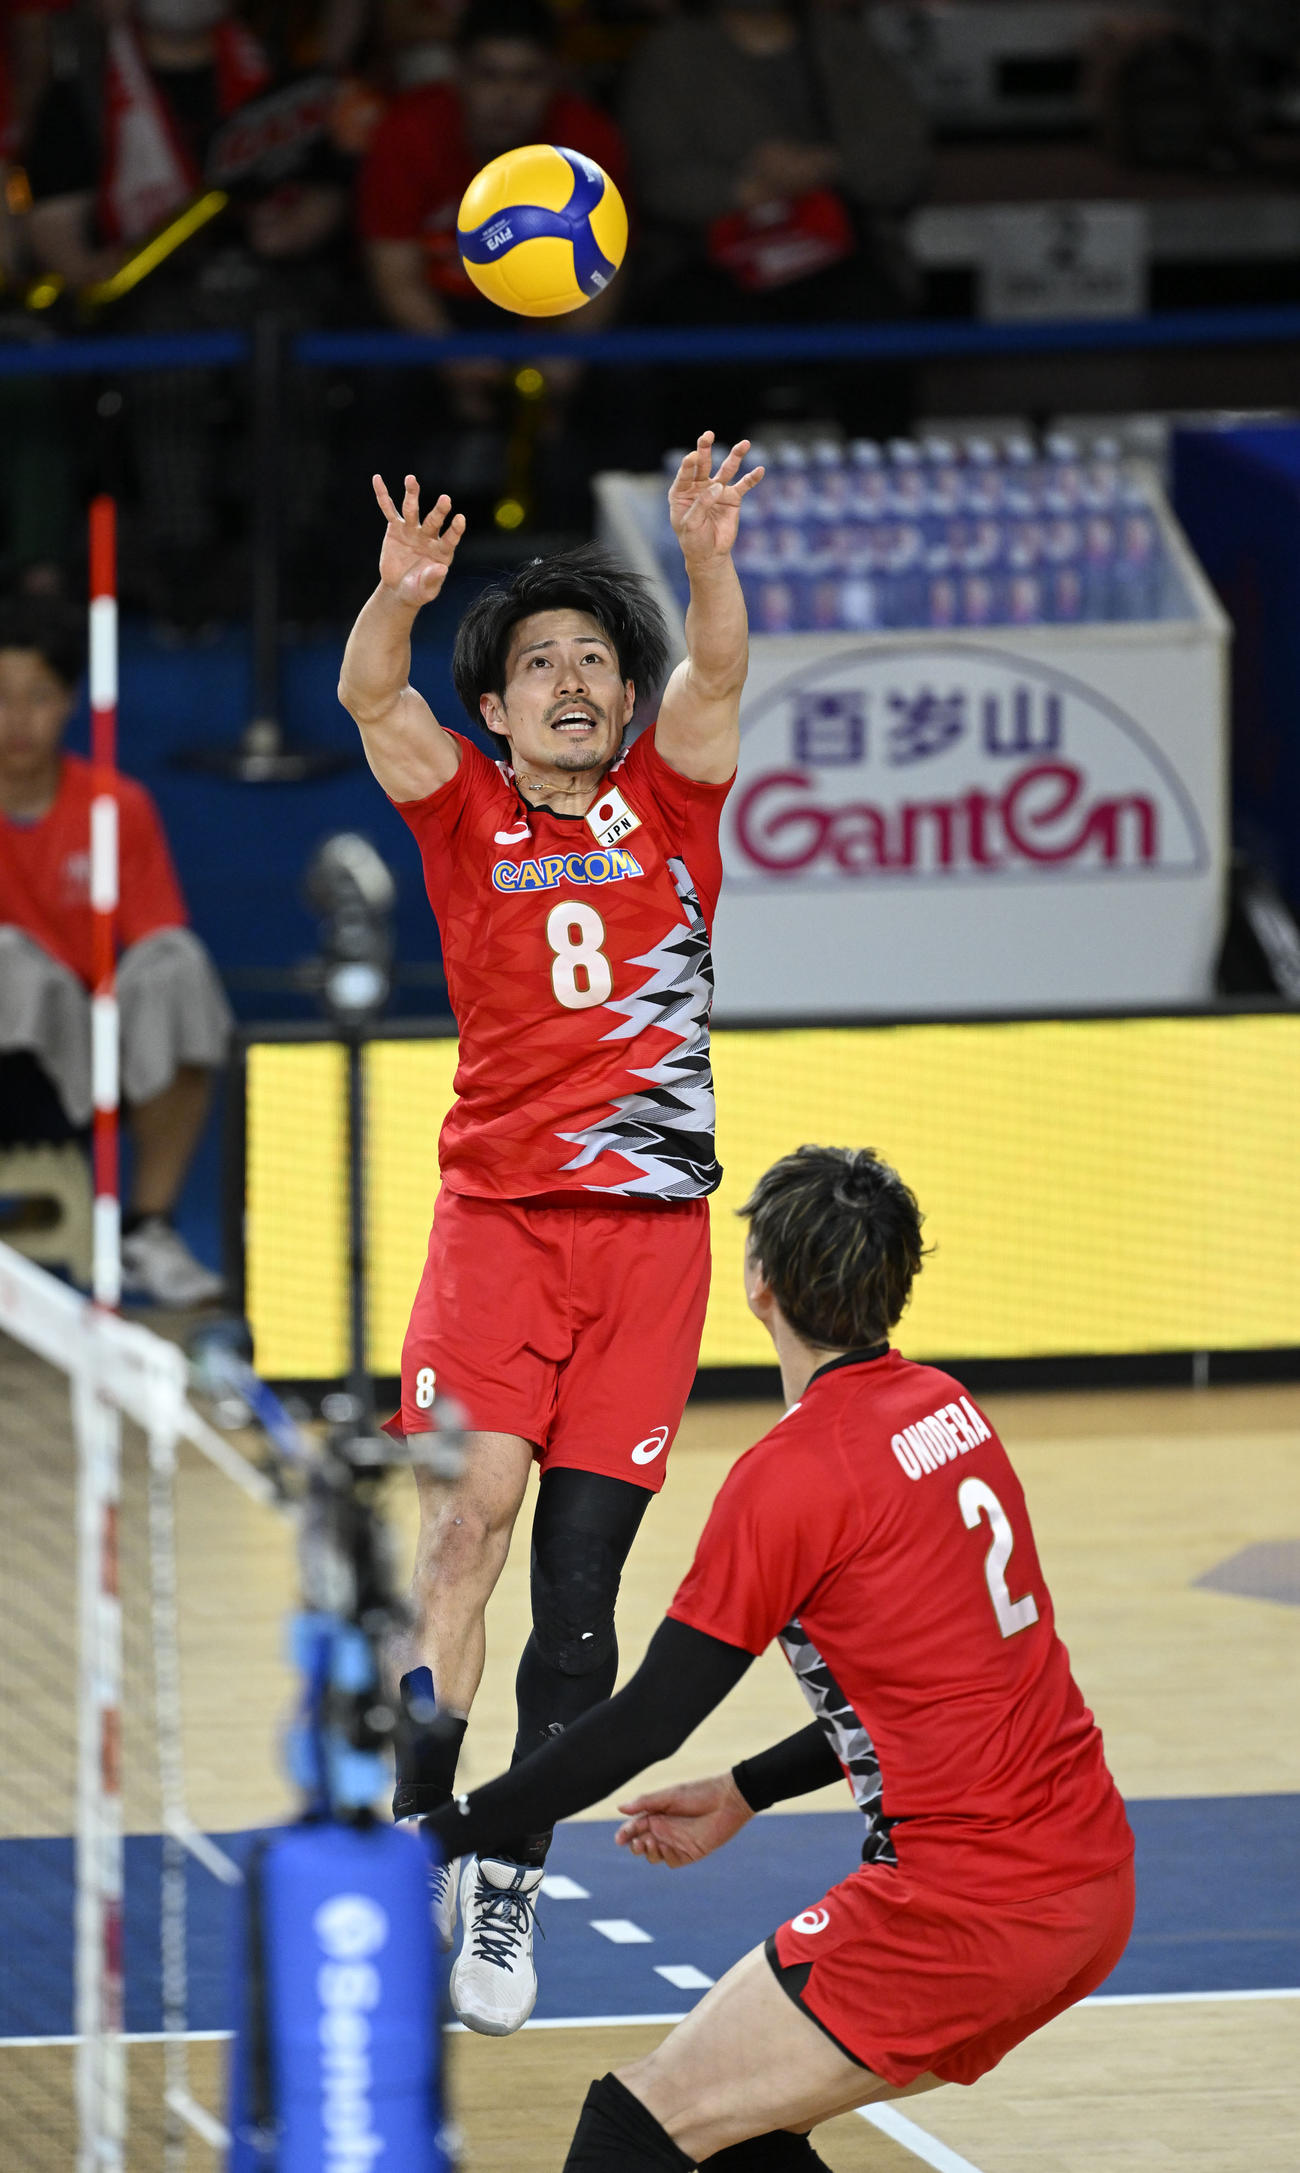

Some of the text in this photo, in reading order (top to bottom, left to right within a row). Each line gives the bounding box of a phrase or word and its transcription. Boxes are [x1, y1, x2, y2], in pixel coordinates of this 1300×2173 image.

[791, 686, 1064, 767] 百岁山
[492, 848, 645, 893] CAPCOM
[607, 817, 632, 843] JPN
[545, 900, 614, 1010] 8
[415, 1367, 436, 1409] 8
[891, 1395, 992, 1481] ONODERA
[958, 1476, 1040, 1640] 2
